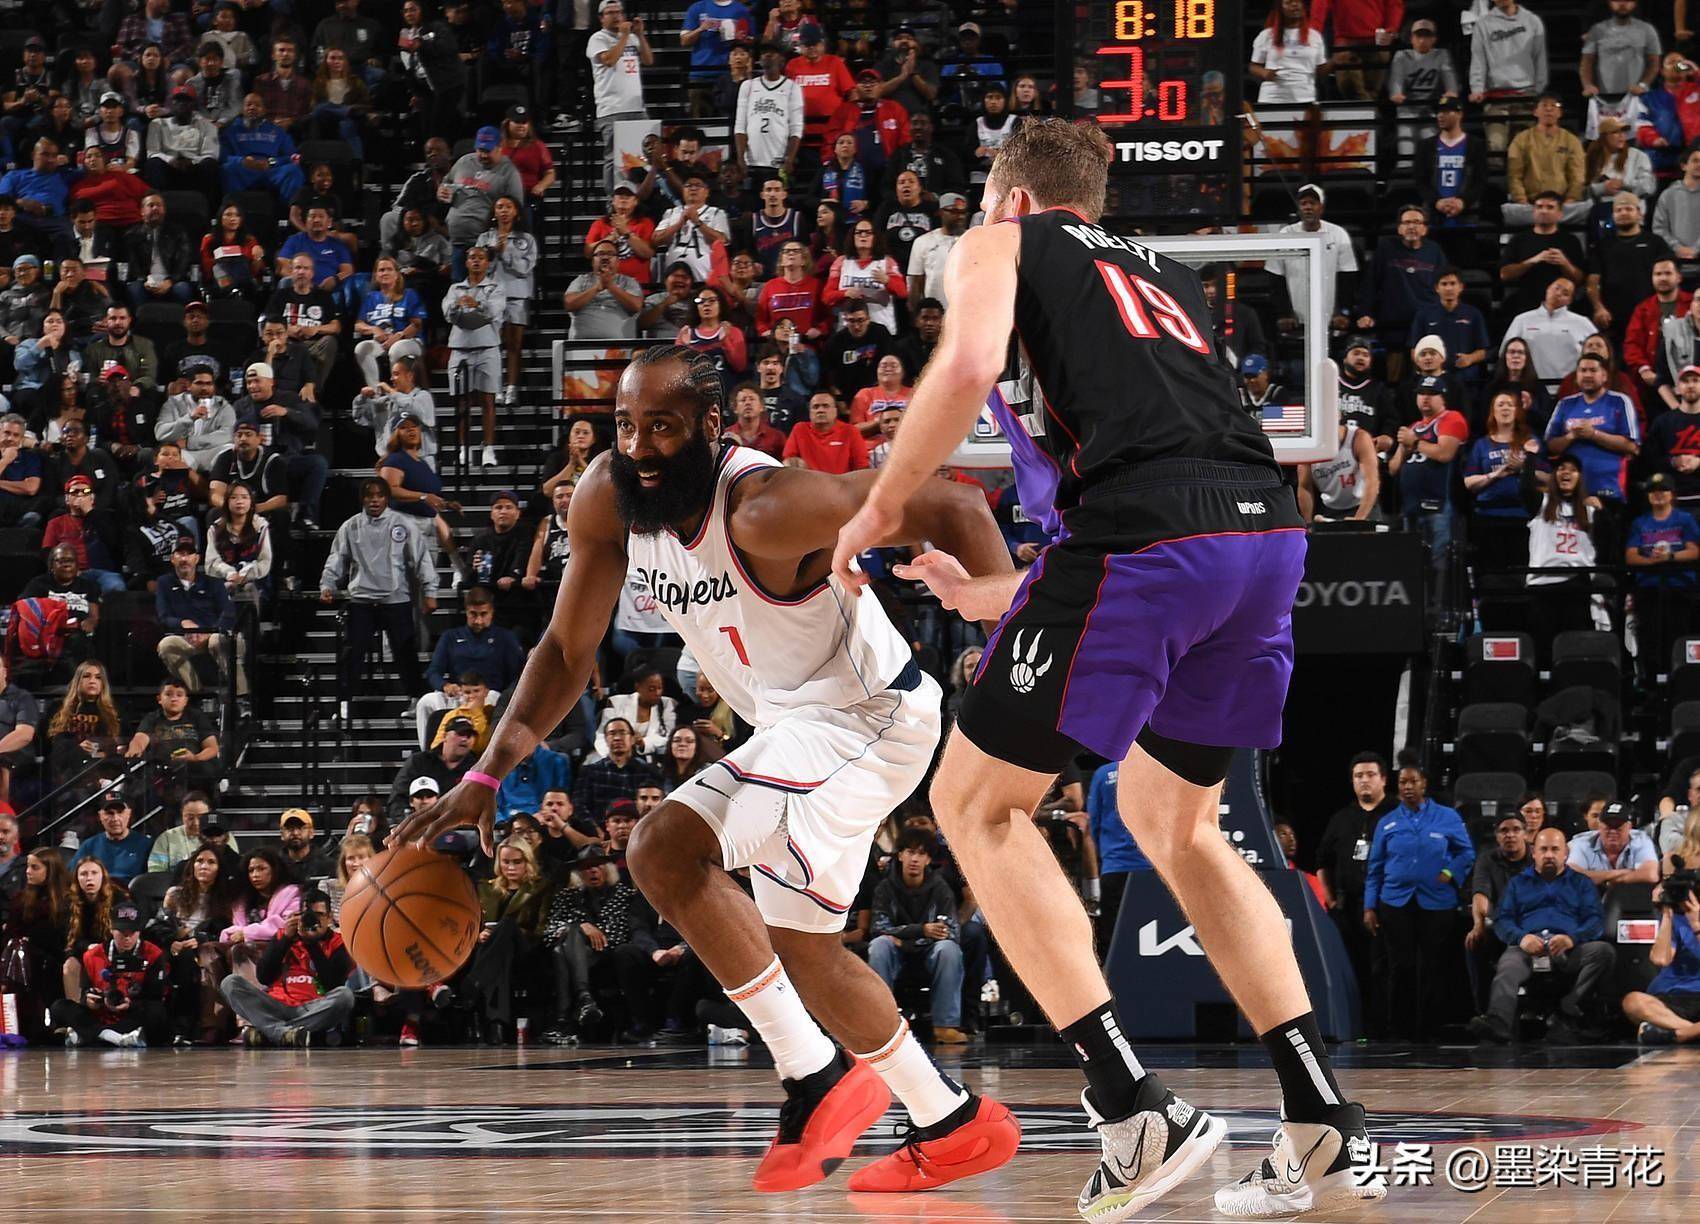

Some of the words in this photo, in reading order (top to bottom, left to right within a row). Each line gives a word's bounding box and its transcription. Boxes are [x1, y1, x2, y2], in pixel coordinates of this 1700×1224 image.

[1115, 0, 1215, 40] 8:18
[760, 117, 770, 133] 2
[1116, 140, 1225, 163] TISSOT
[1093, 258, 1211, 355] 19
[1555, 532, 1579, 554] 22
[1295, 580, 1412, 608] OYOTA
